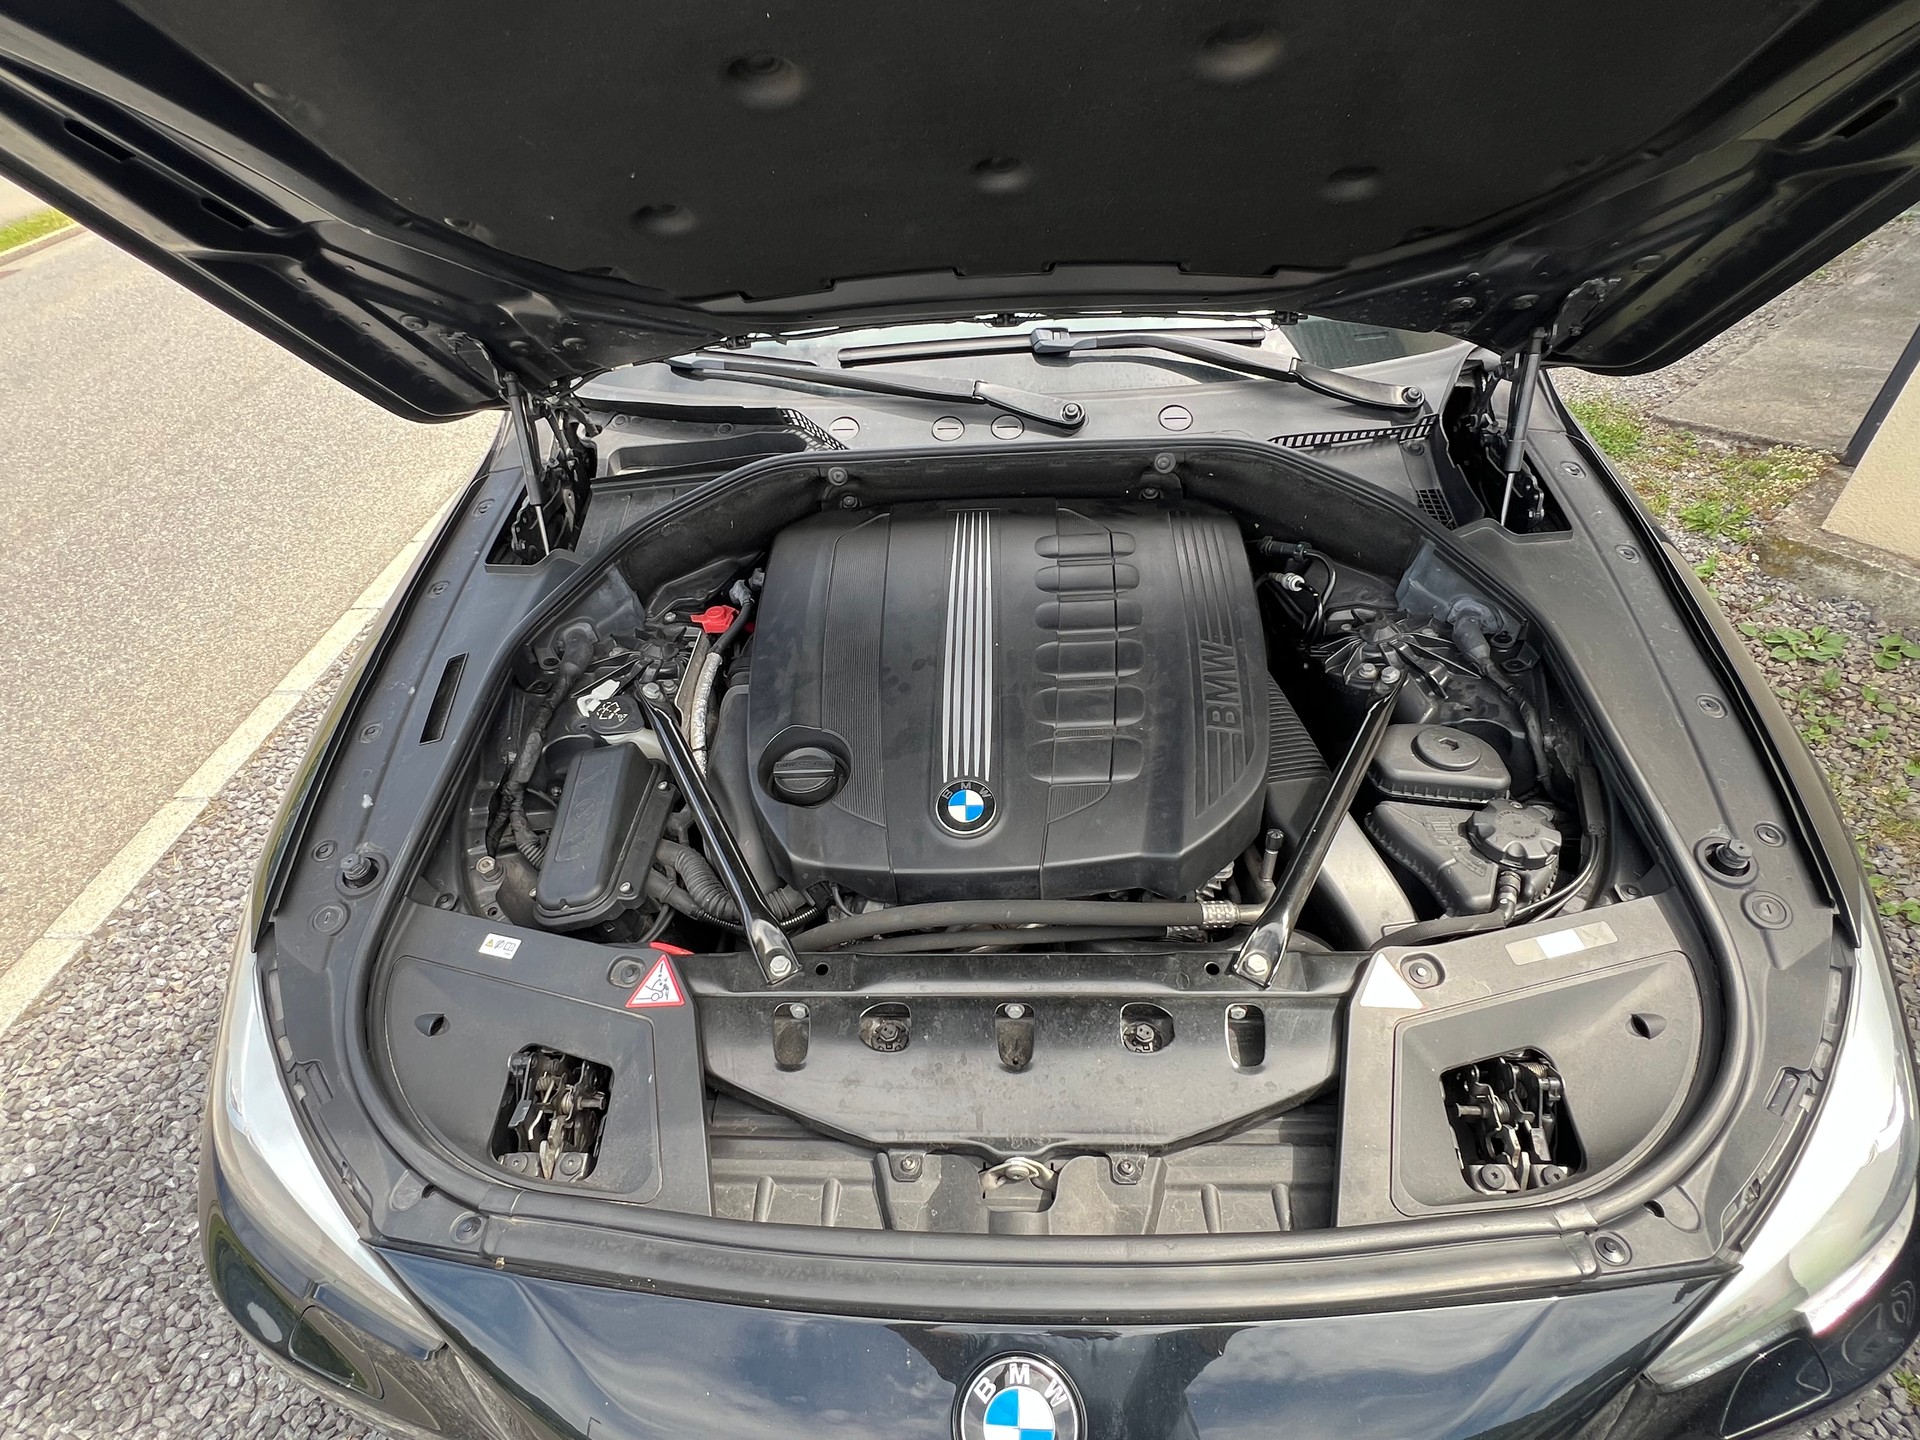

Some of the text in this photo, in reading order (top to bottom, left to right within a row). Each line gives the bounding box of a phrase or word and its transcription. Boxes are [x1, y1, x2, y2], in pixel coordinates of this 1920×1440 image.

[1200, 639, 1243, 729] BMW
[941, 782, 992, 800] BMW
[973, 1362, 1068, 1408] BMW
